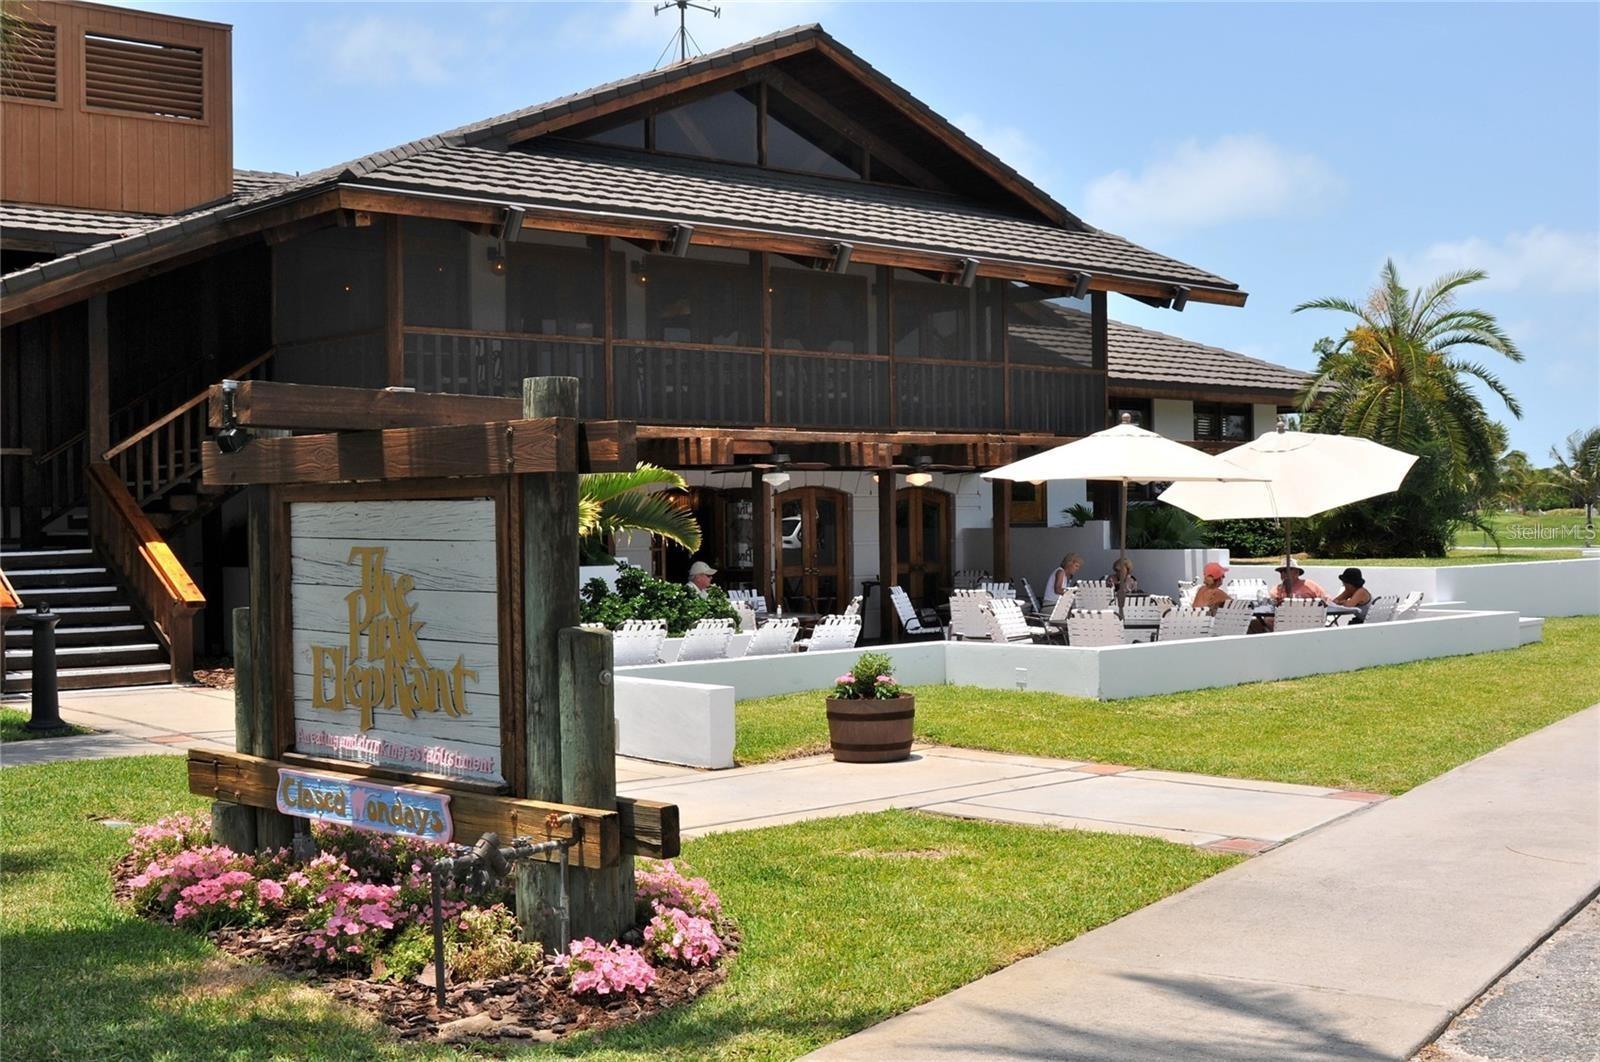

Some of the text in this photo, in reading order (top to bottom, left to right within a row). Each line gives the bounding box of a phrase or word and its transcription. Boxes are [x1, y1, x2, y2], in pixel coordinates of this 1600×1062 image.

[347, 546, 419, 619] The
[344, 588, 432, 672] Pink
[310, 645, 480, 732] Elephant
[281, 777, 346, 817] Closed
